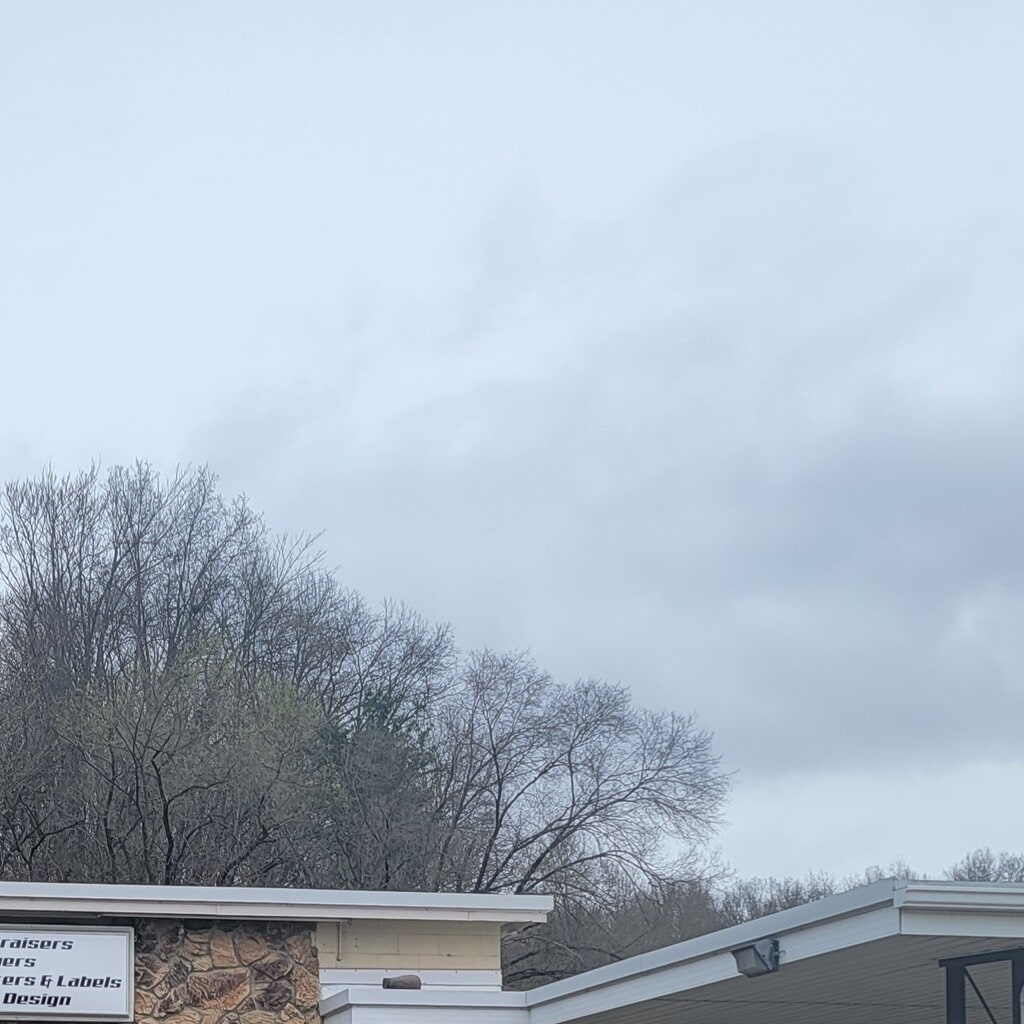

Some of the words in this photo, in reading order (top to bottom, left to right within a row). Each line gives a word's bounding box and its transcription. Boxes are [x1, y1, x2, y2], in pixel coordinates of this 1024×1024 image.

[39, 974, 53, 989] &
[56, 975, 122, 989] Labels
[2, 992, 72, 1008] Design
